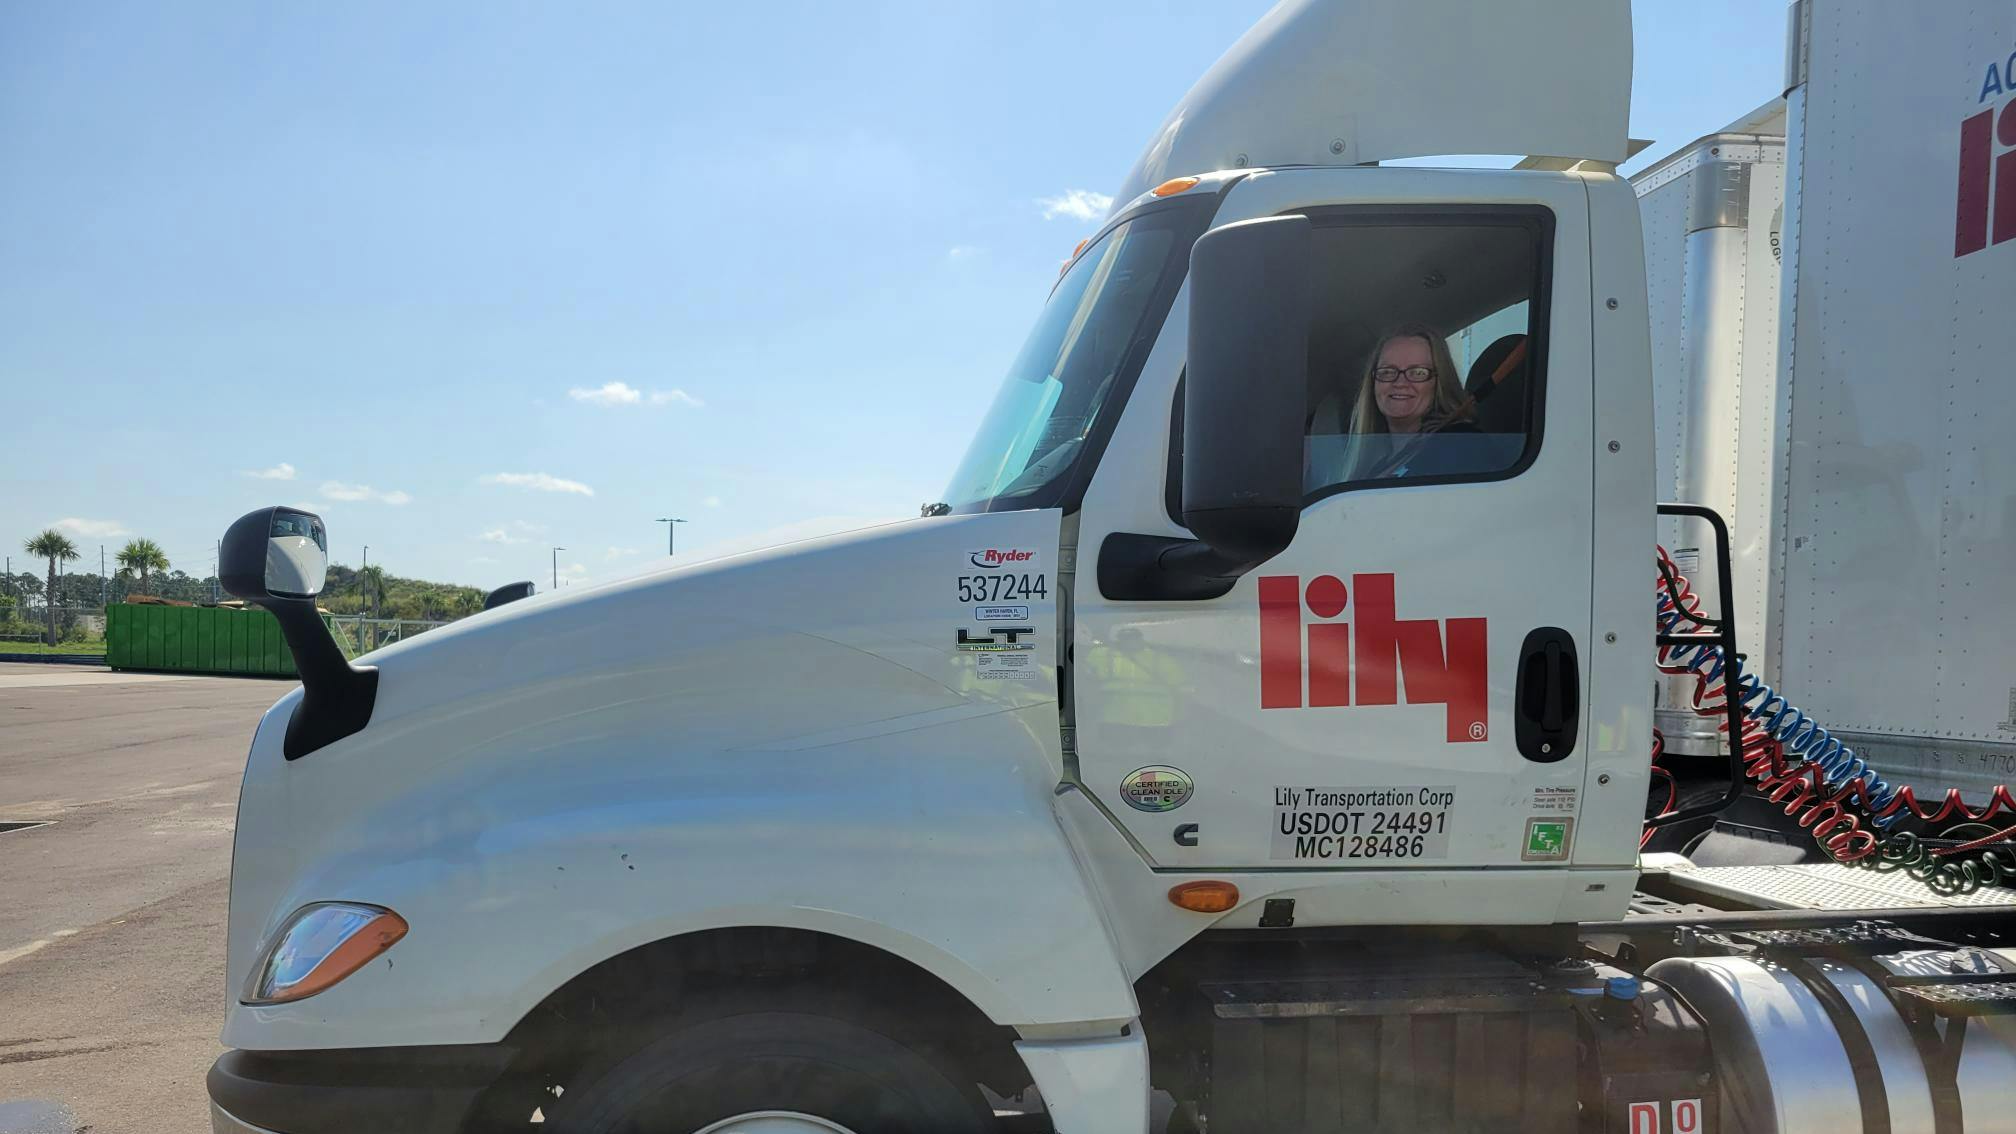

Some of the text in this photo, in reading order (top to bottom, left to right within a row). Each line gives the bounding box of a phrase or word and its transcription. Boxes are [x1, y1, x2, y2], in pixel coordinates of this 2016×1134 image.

[984, 549, 1033, 564] Ryder
[958, 574, 1047, 602] 537244
[957, 627, 1034, 644] LT
[1258, 572, 1488, 743] lily
[1135, 780, 1179, 788] CERTIFIED
[1275, 787, 1453, 810] Lily Transportation Corp
[1280, 811, 1446, 835] USDOT 24491
[1295, 835, 1424, 858] MC128486
